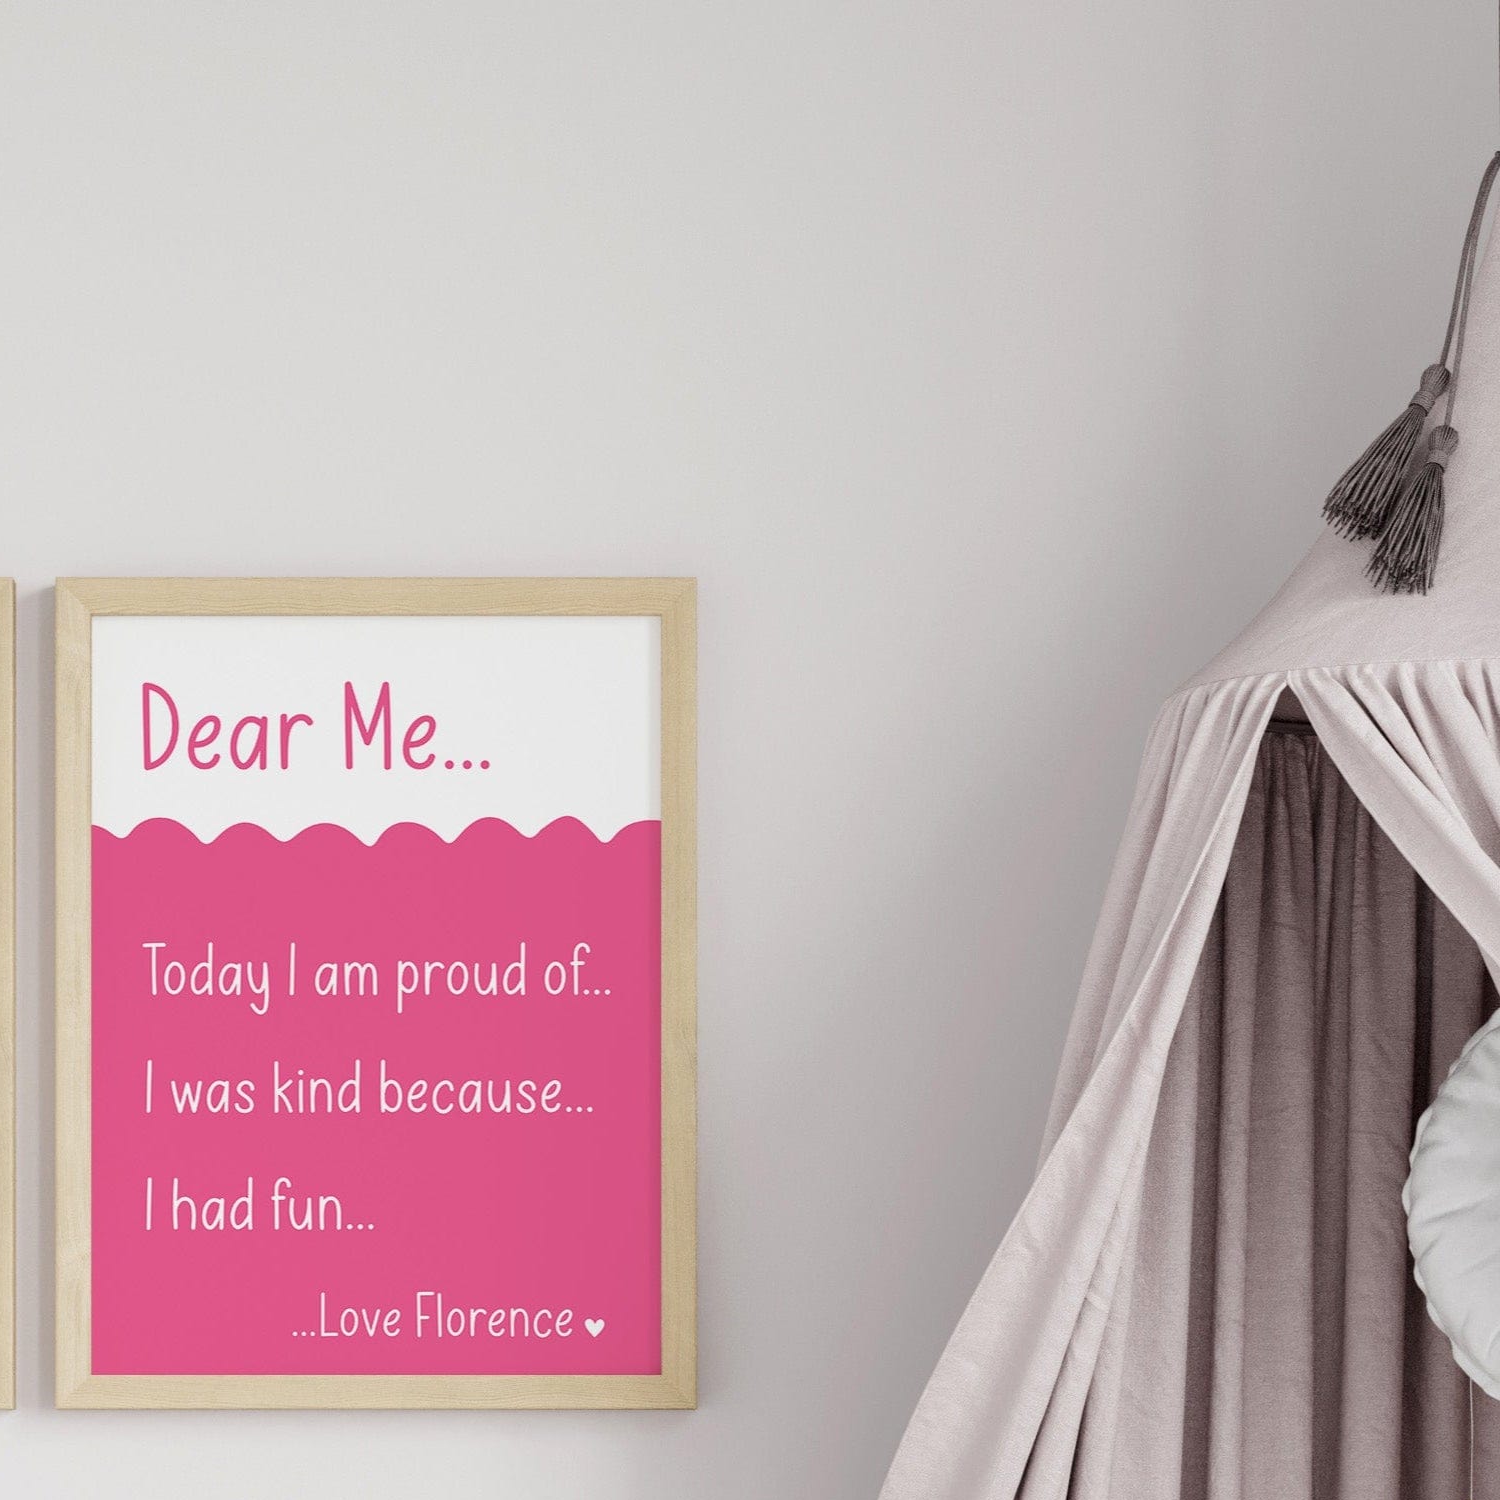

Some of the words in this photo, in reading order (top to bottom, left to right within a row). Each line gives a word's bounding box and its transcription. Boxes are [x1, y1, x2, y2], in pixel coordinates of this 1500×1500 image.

[140, 680, 315, 772] Dear
[343, 680, 492, 772] Me...
[142, 941, 270, 1016] Today
[288, 941, 297, 997] I
[314, 961, 379, 996] am
[397, 941, 526, 1014] proud
[544, 942, 612, 997] of...
[145, 1059, 153, 1114] I
[170, 1079, 256, 1114] was
[273, 1059, 362, 1114] kind
[379, 1059, 594, 1115] because...
[145, 1177, 153, 1231] I
[172, 1176, 254, 1231] had
[270, 1176, 376, 1231] fun...
[416, 1291, 573, 1338] Florence
